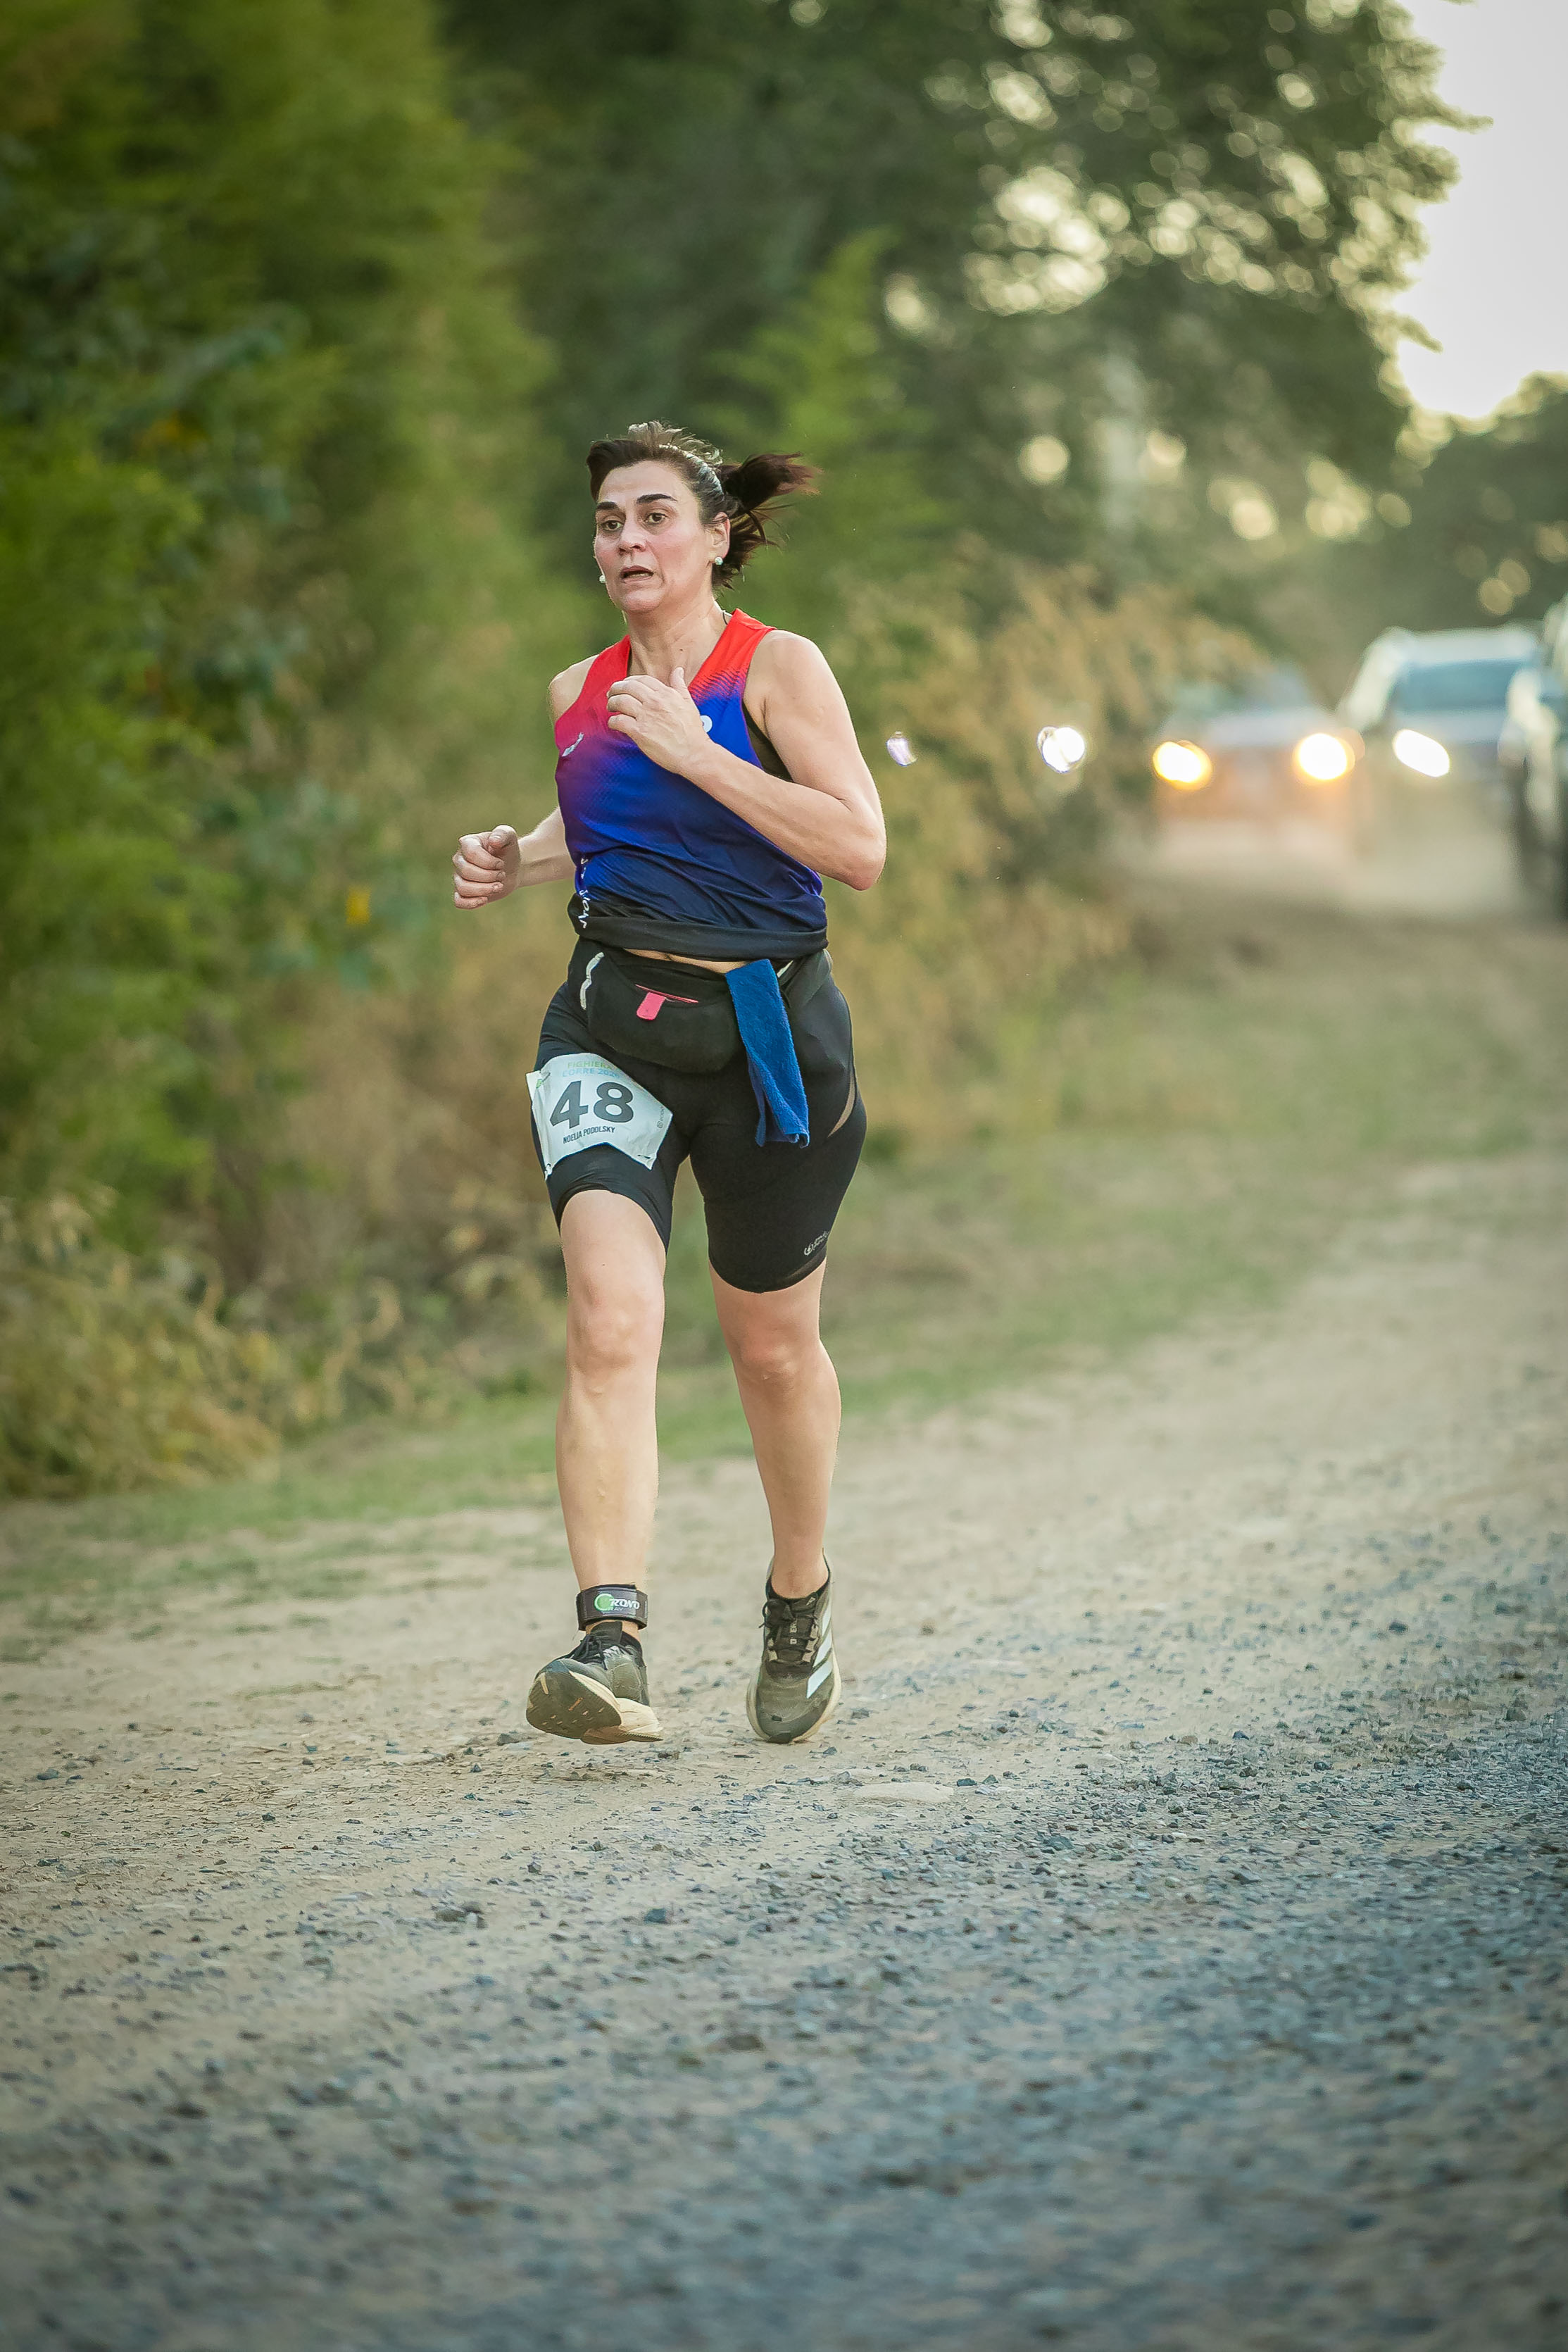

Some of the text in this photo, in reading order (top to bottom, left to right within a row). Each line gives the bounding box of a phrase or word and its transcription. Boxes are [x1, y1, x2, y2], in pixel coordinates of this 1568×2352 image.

[563, 1068, 596, 1077] CORRE
[550, 1080, 634, 1129] 48
[563, 1125, 615, 1144] NOELIA PODOLSKY
